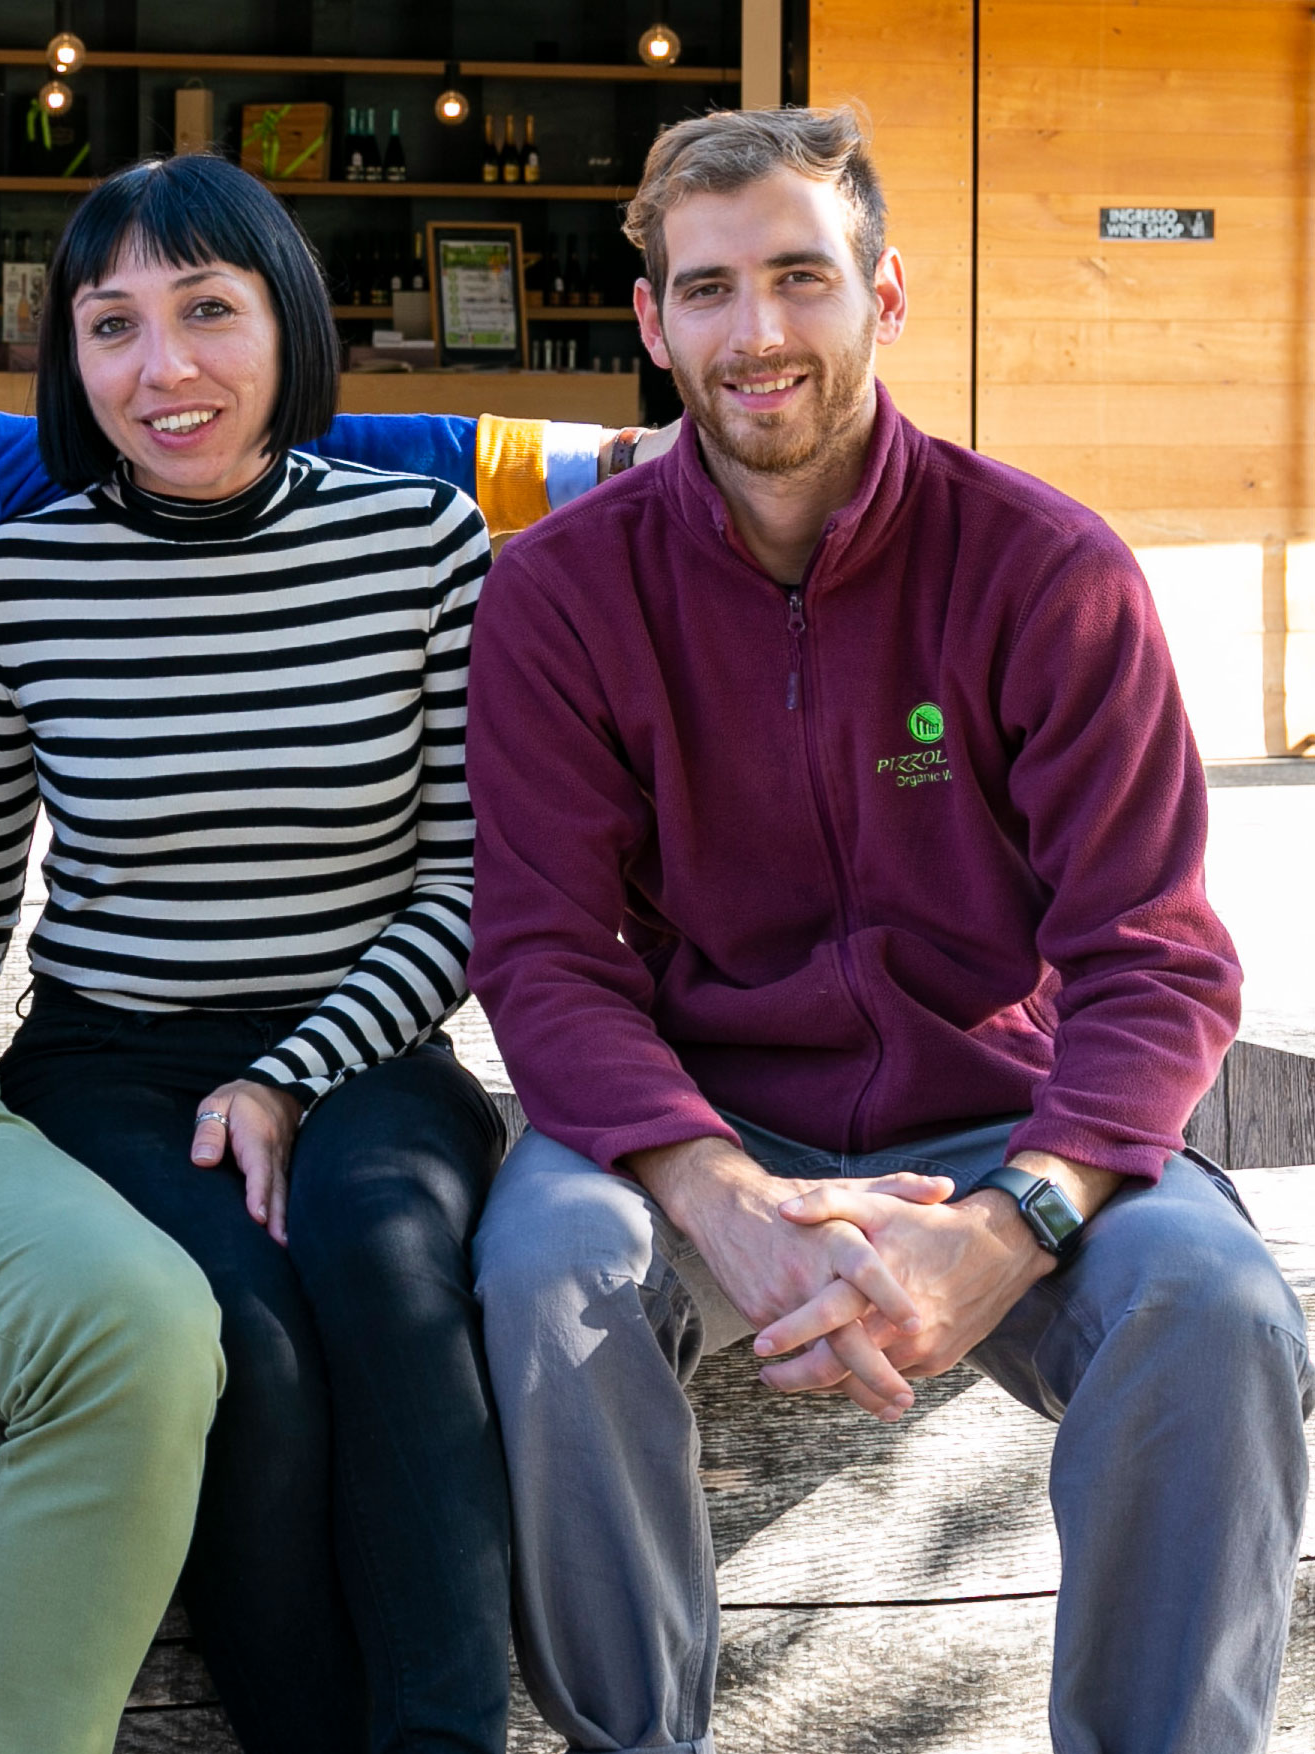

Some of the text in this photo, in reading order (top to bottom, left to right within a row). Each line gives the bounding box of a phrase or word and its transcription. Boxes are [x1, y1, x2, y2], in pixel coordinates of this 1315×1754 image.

[1109, 208, 1178, 223] INGRESSO
[1106, 222, 1184, 238] WINE SHOP
[896, 773, 941, 787] Organic
